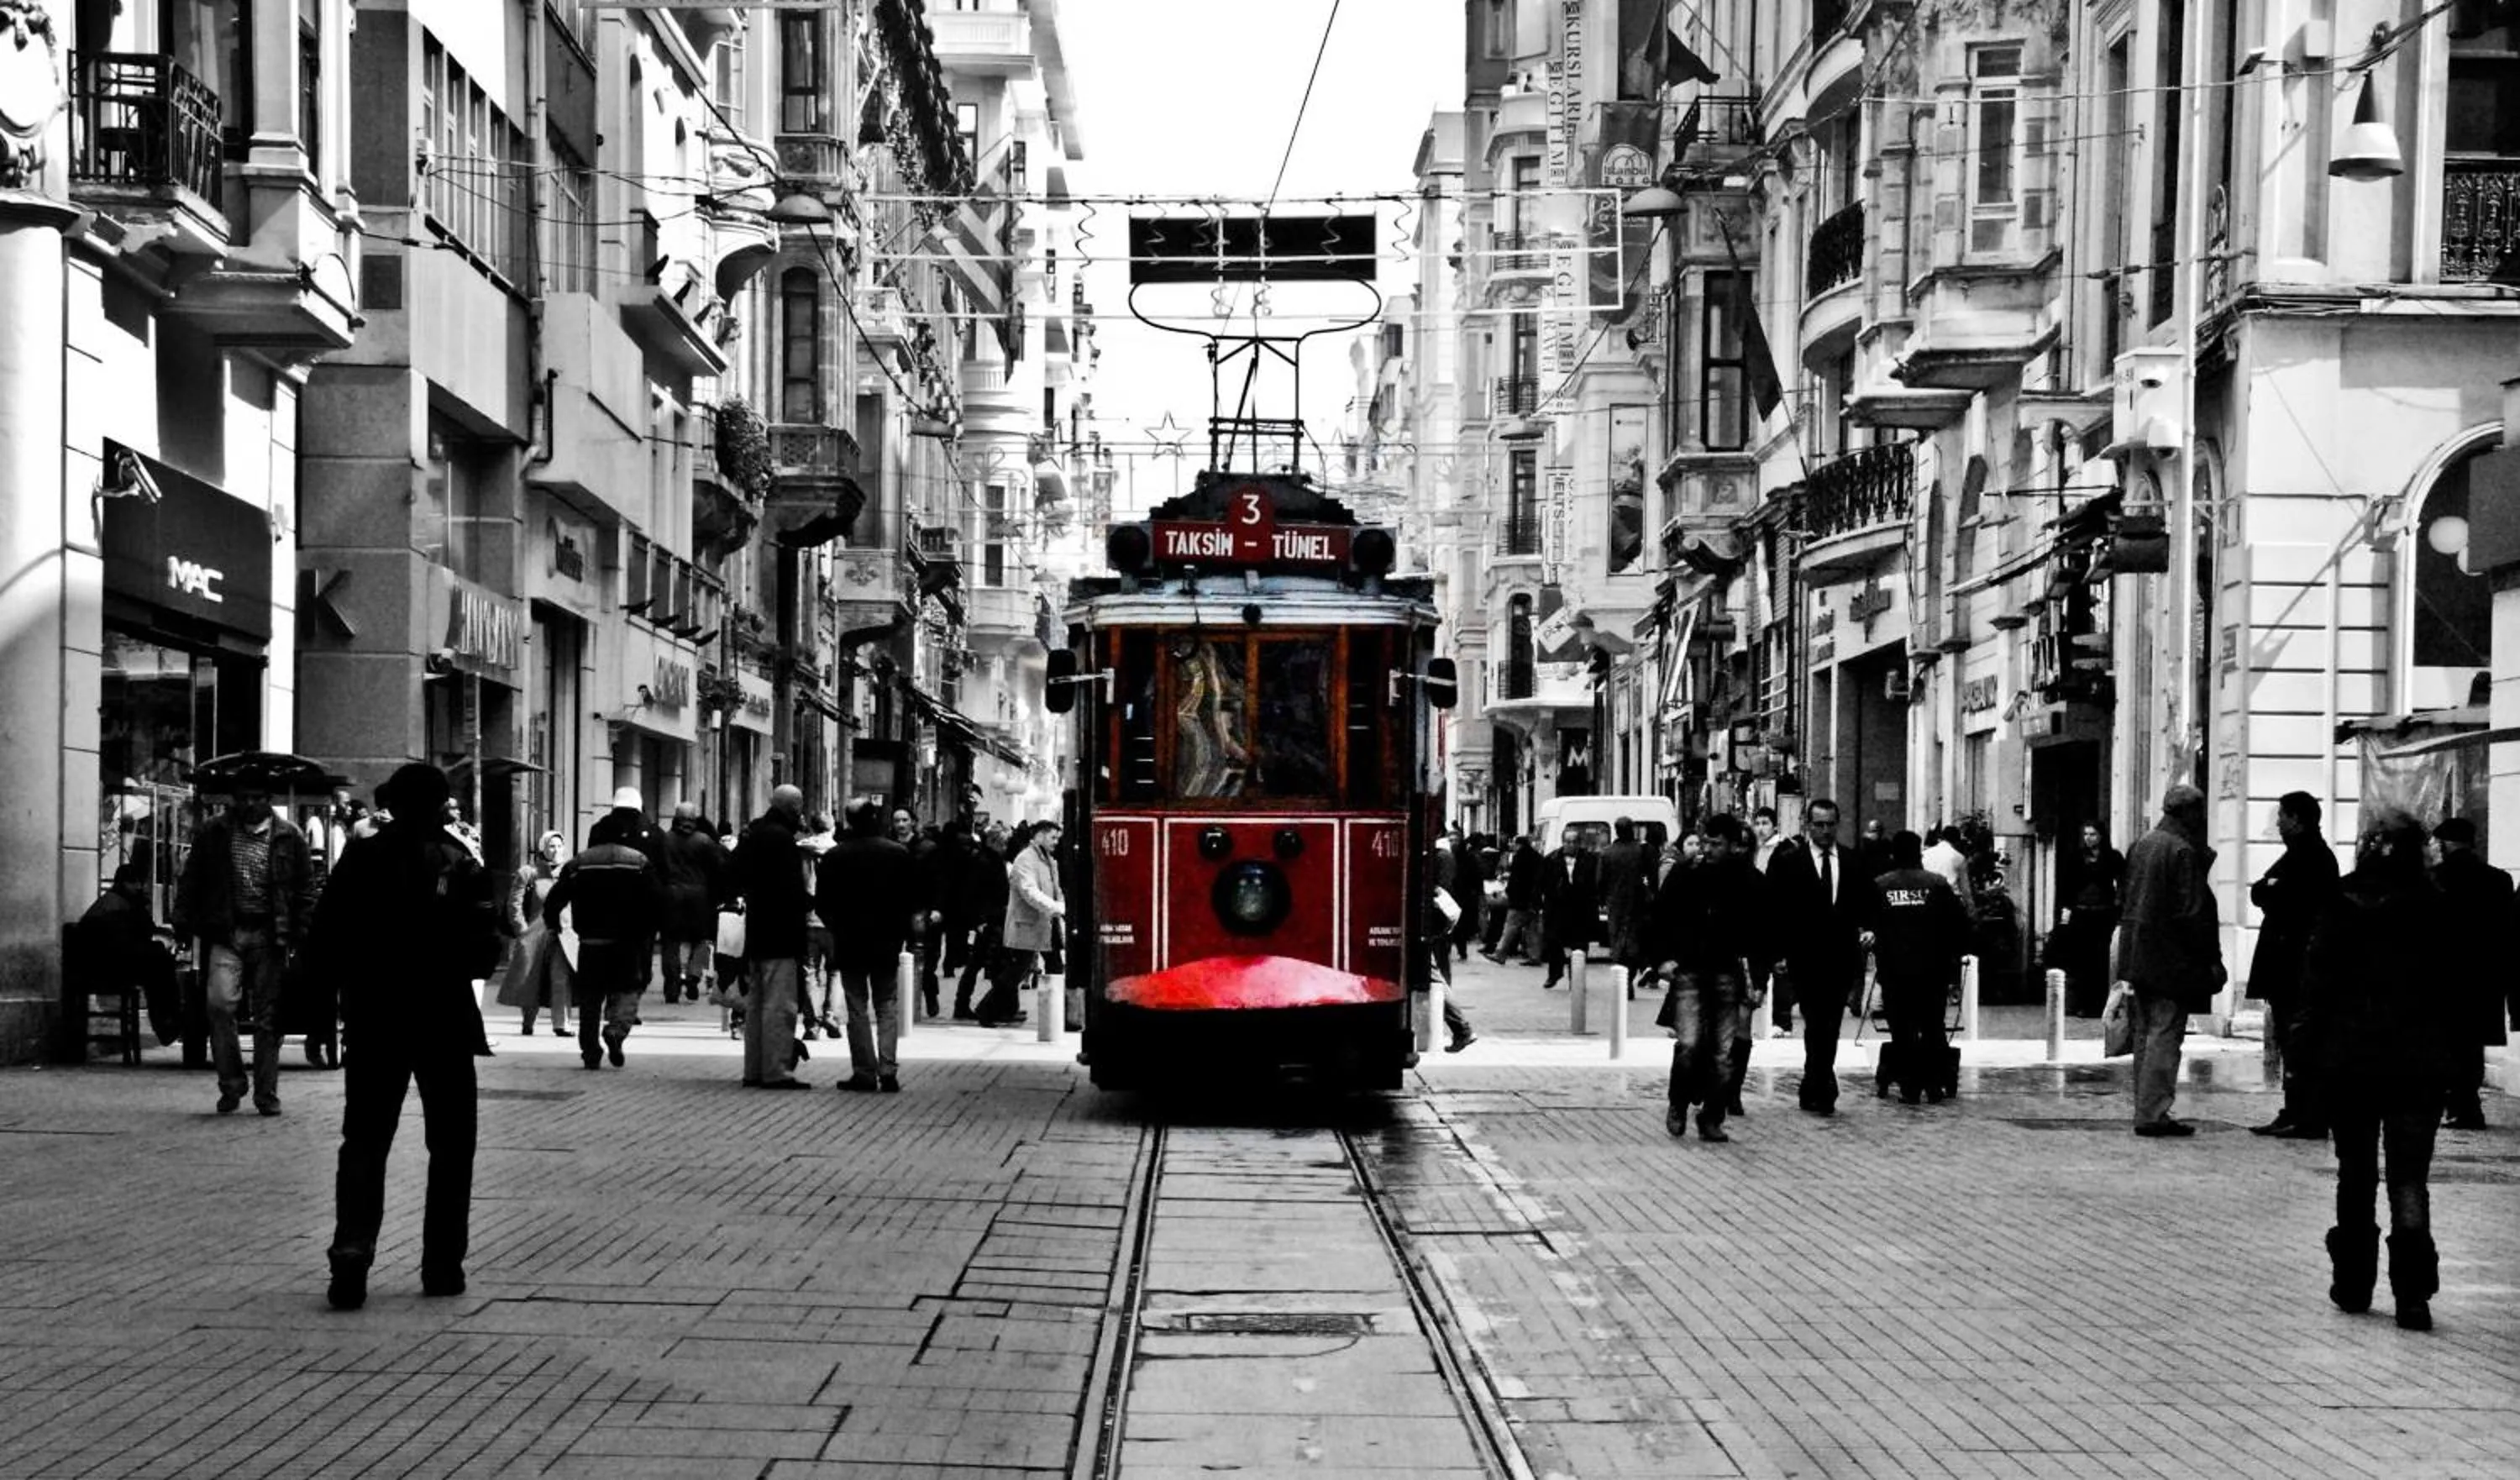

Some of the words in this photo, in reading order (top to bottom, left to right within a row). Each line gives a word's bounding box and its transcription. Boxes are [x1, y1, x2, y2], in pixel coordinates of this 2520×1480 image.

[1241, 494, 1261, 525] 3
[1165, 528, 1234, 557] TAKSİM
[1272, 530, 1336, 560] TÜNEL
[1101, 828, 1129, 856] 410
